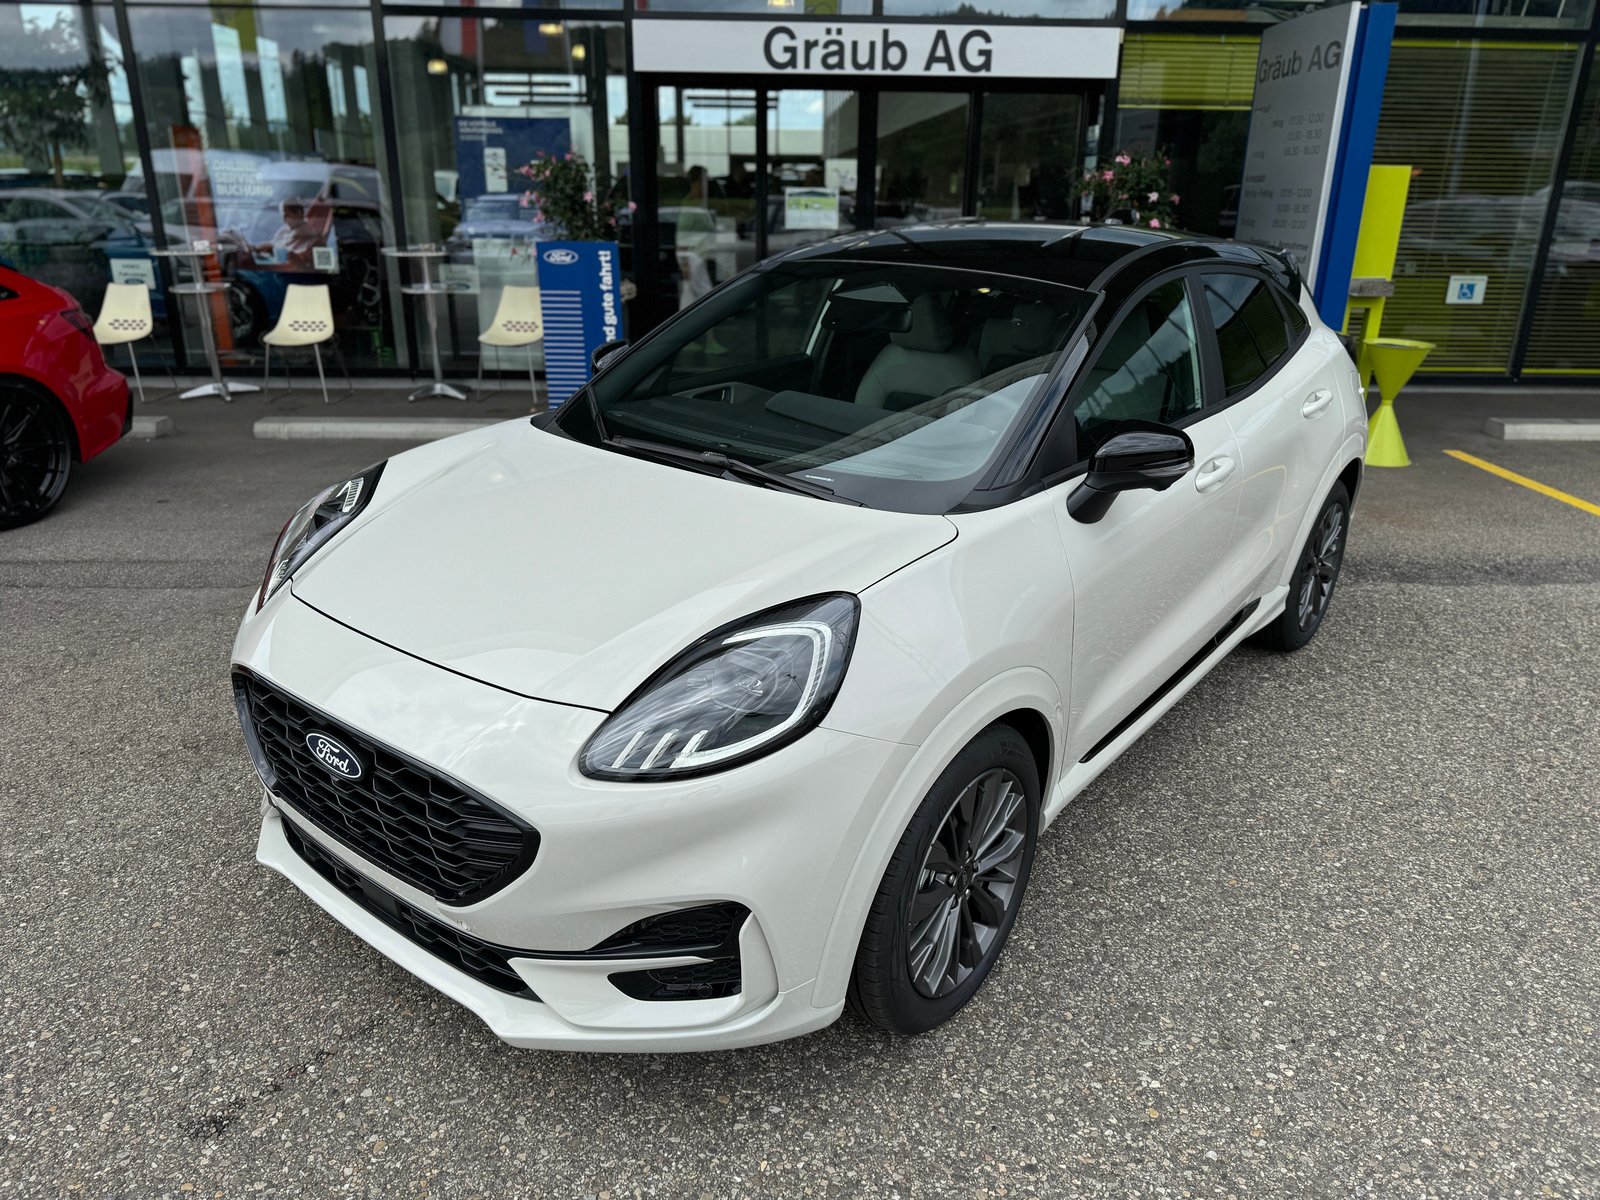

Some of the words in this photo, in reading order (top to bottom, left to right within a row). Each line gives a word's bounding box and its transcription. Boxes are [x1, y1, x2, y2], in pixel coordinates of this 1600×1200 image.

[763, 25, 908, 71] Gräub
[923, 29, 993, 73] AG
[1259, 50, 1302, 83] Gräub
[1307, 40, 1342, 72] AG
[217, 185, 273, 197] BUCHUNG
[598, 250, 613, 292] fahrt!
[602, 292, 618, 326] gute
[603, 326, 616, 343] nd
